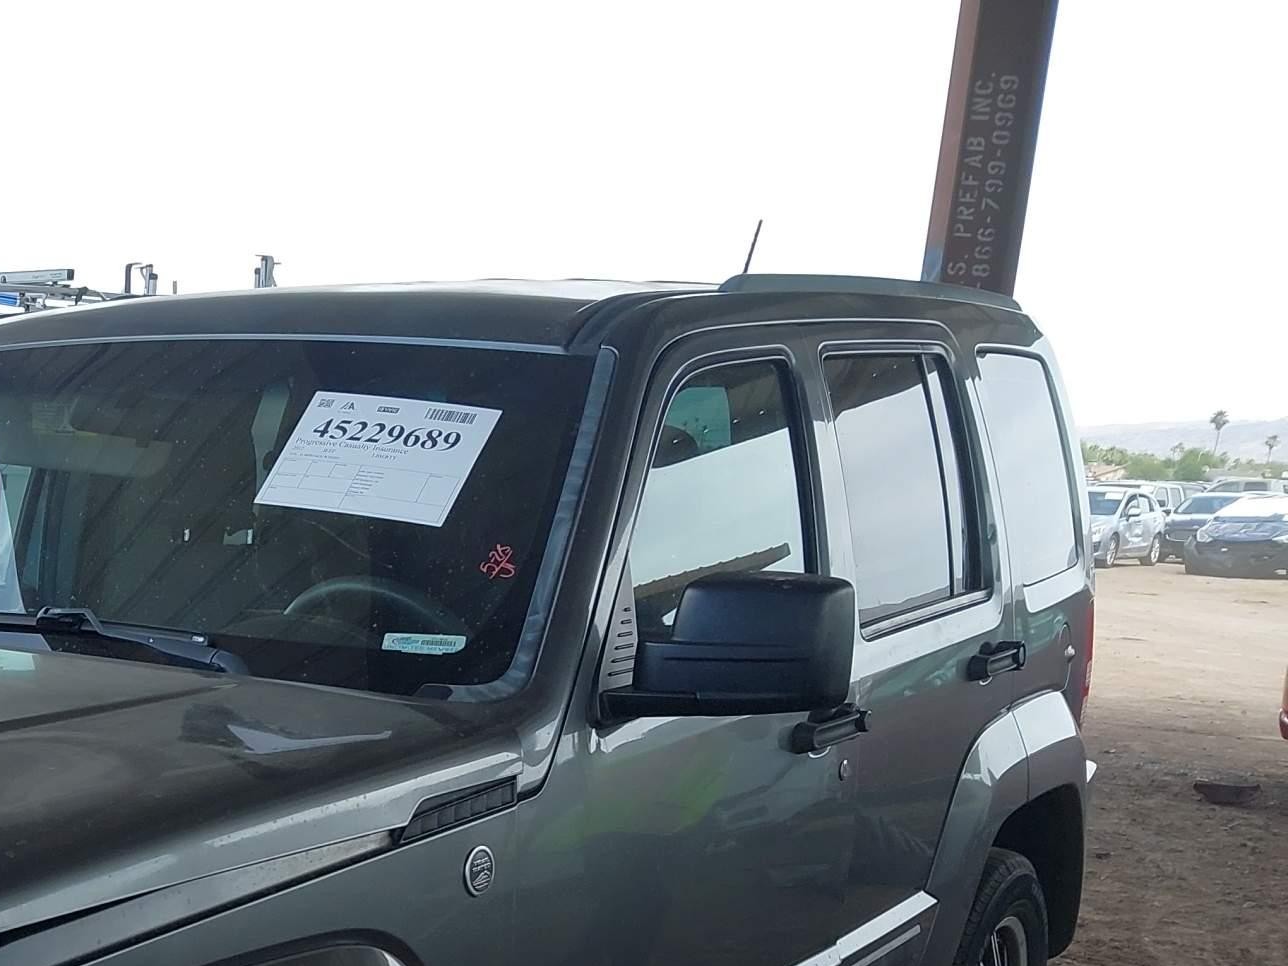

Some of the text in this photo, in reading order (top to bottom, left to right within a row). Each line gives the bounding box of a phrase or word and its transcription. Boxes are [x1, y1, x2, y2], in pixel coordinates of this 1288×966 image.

[953, 136, 985, 238] PREFAB
[970, 72, 997, 121] INC.
[971, 74, 1020, 289] -866-799-0969
[295, 437, 409, 455] Progressive Casualty Insurance
[312, 418, 462, 452] 45229689
